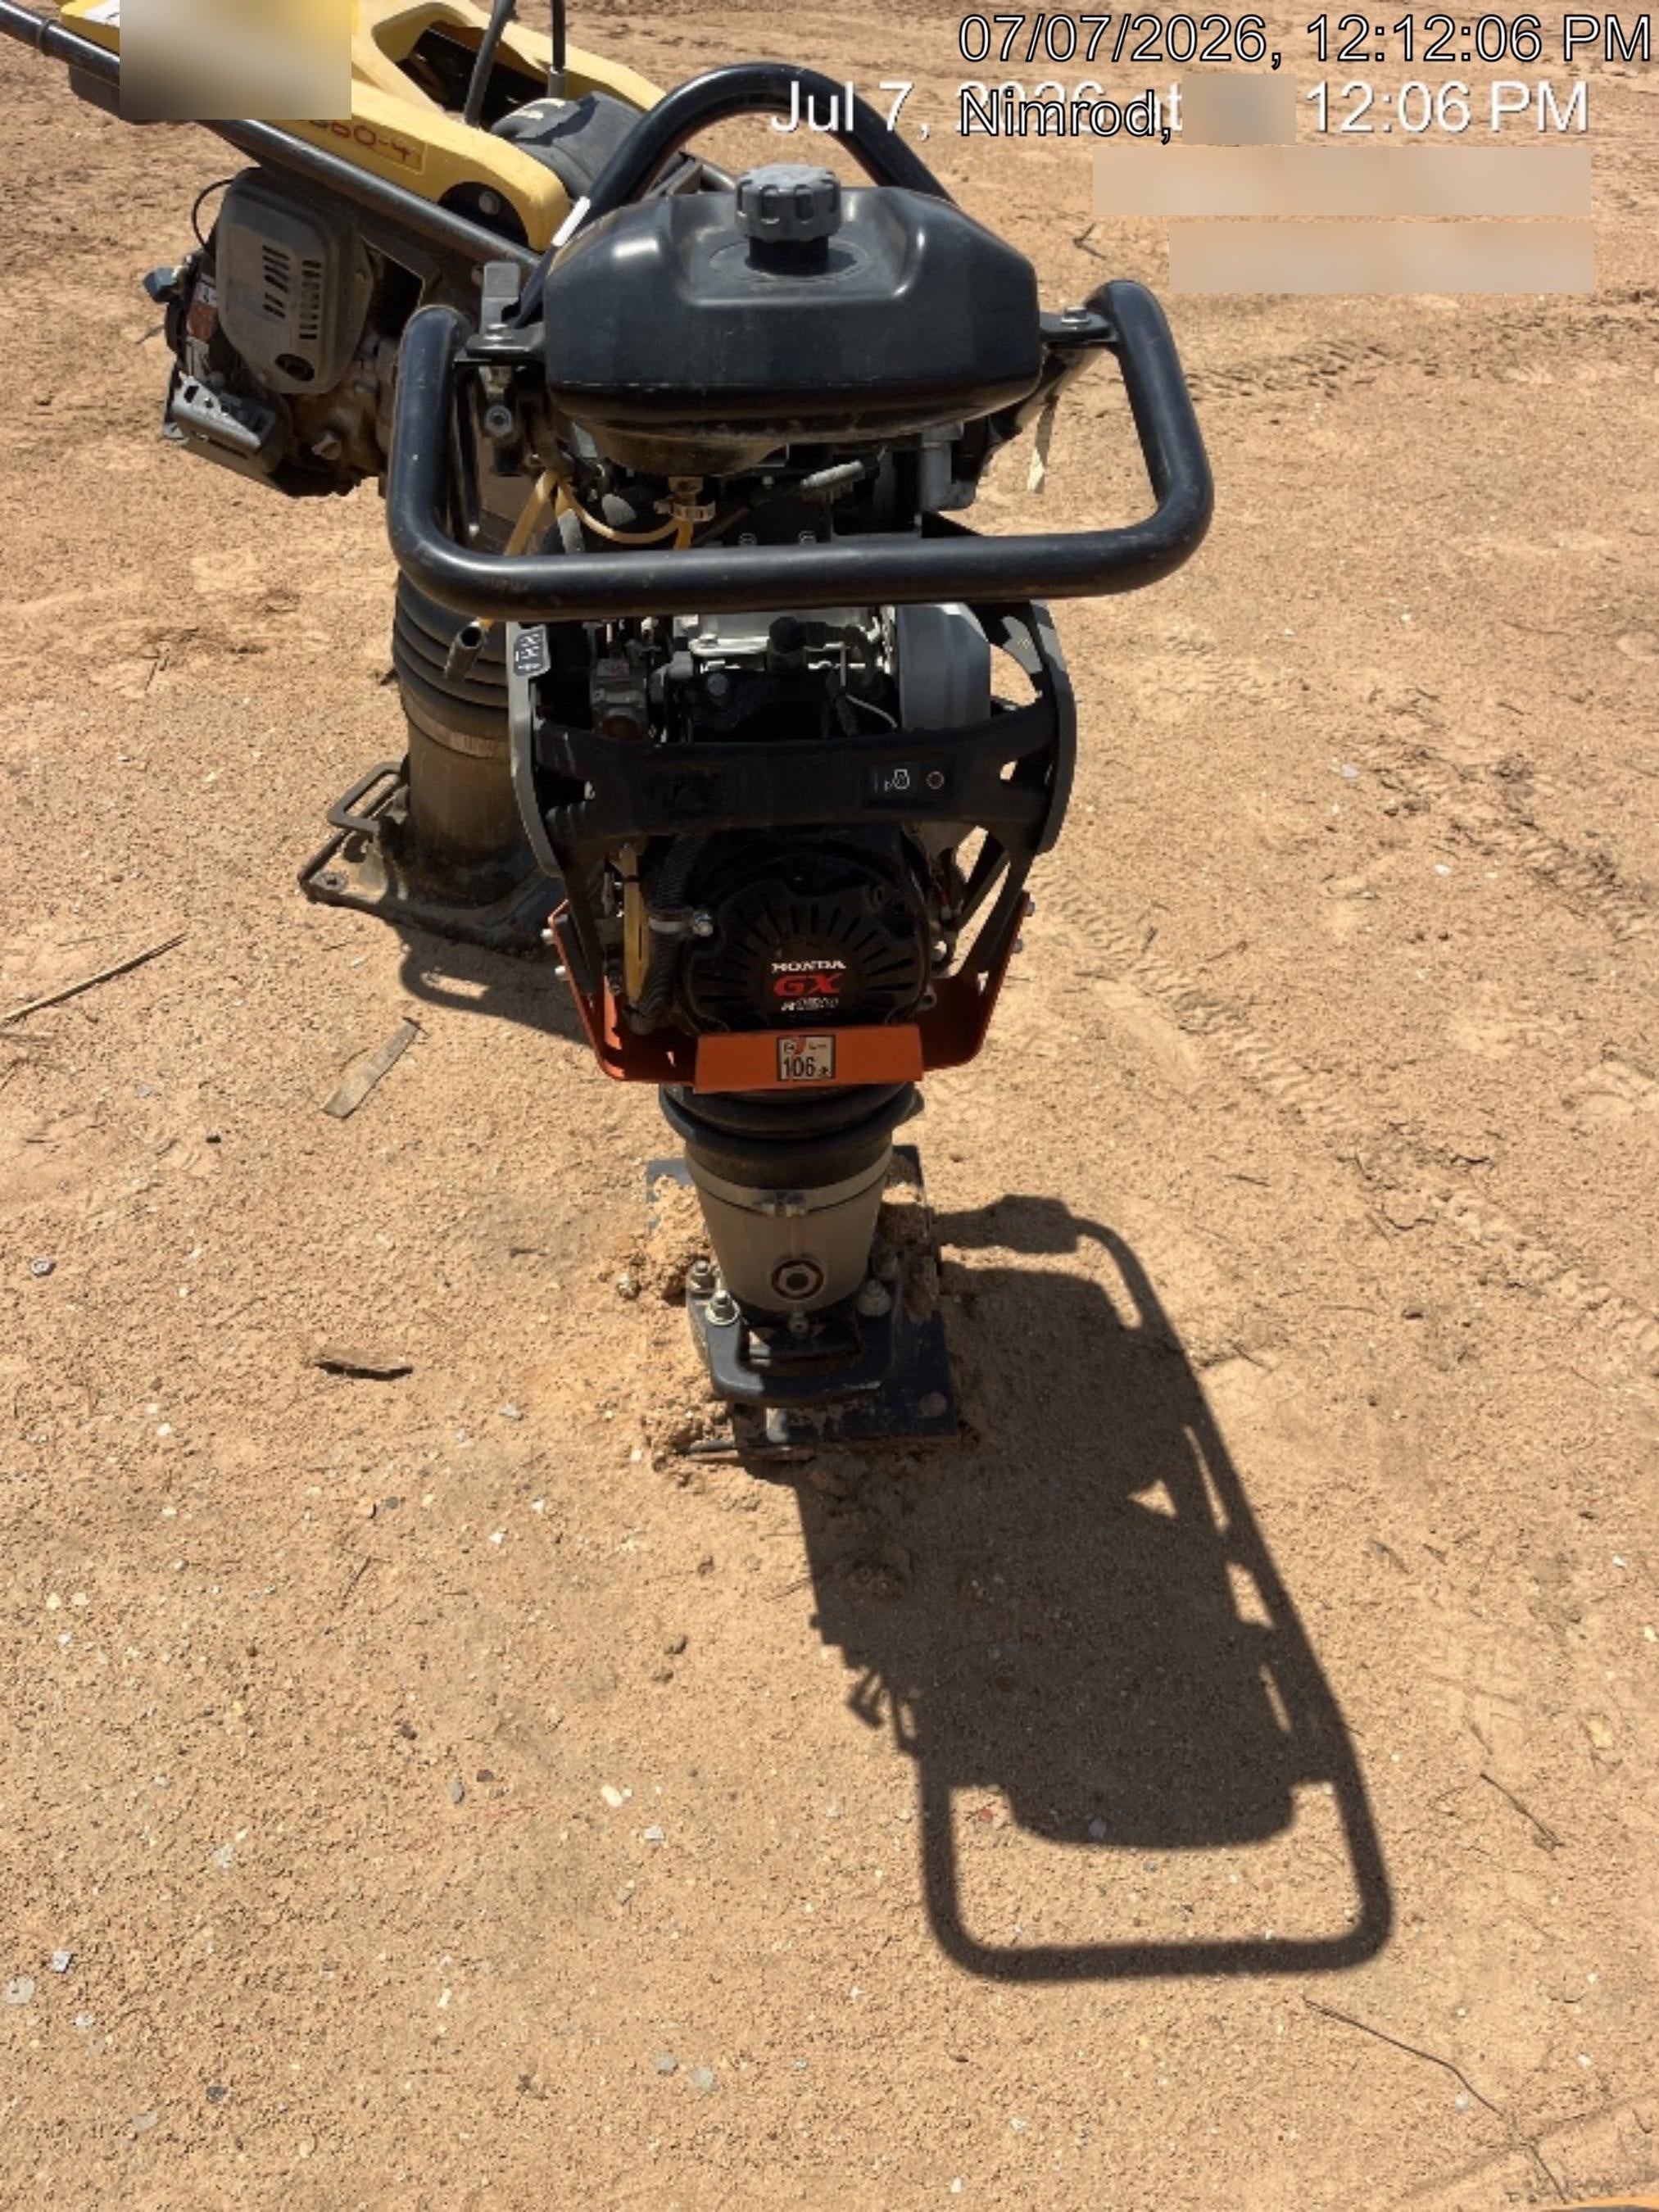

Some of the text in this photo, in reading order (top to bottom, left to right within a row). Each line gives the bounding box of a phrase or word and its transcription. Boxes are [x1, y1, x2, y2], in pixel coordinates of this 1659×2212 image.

[771, 960, 846, 972] HONDA
[774, 973, 841, 996] GX
[783, 1056, 816, 1077] 106
